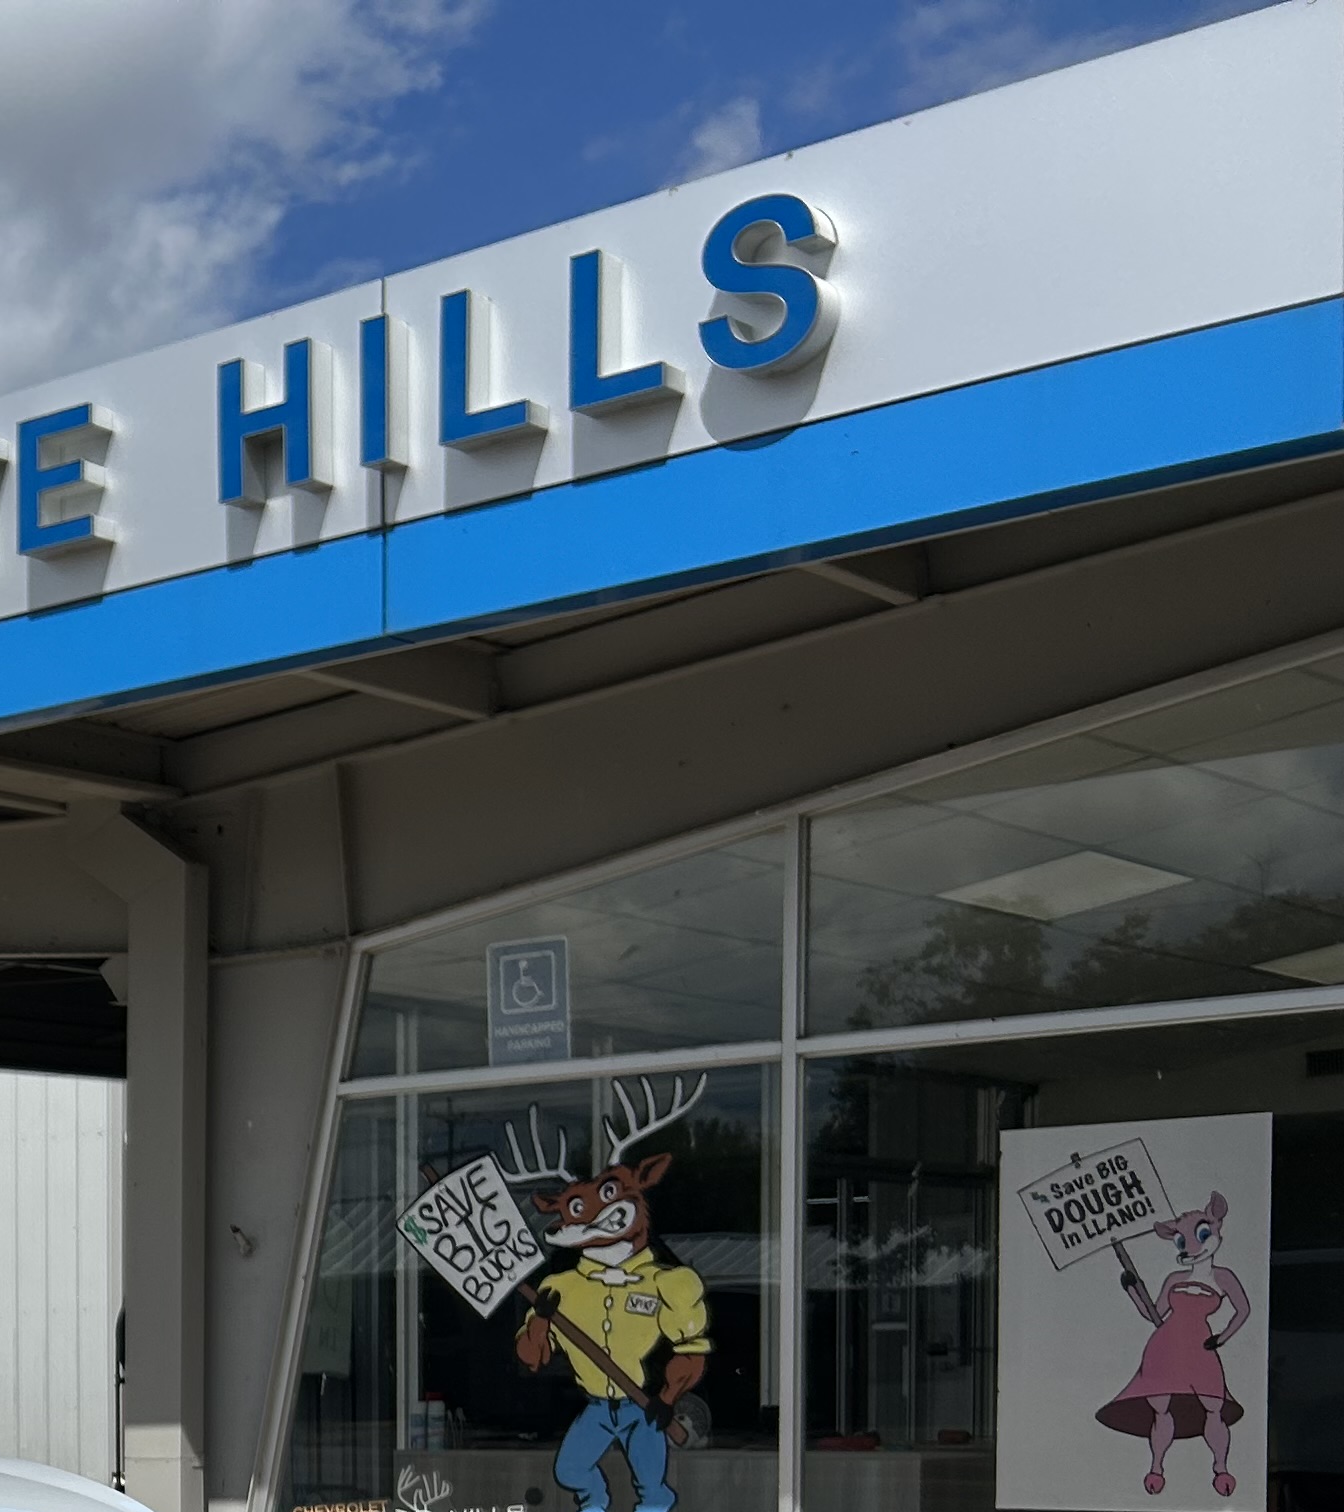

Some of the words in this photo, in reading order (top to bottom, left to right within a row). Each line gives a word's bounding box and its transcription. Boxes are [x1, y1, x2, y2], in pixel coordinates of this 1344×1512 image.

[217, 192, 833, 505] HILLS
[1044, 1170, 1146, 1233] DOUGH
[1050, 1173, 1095, 1199] Save
[1096, 1155, 1129, 1179] BIG
[433, 1201, 511, 1273] BIG
[1081, 1196, 1156, 1239] LLANO!
[463, 1228, 538, 1305] BUCKS
